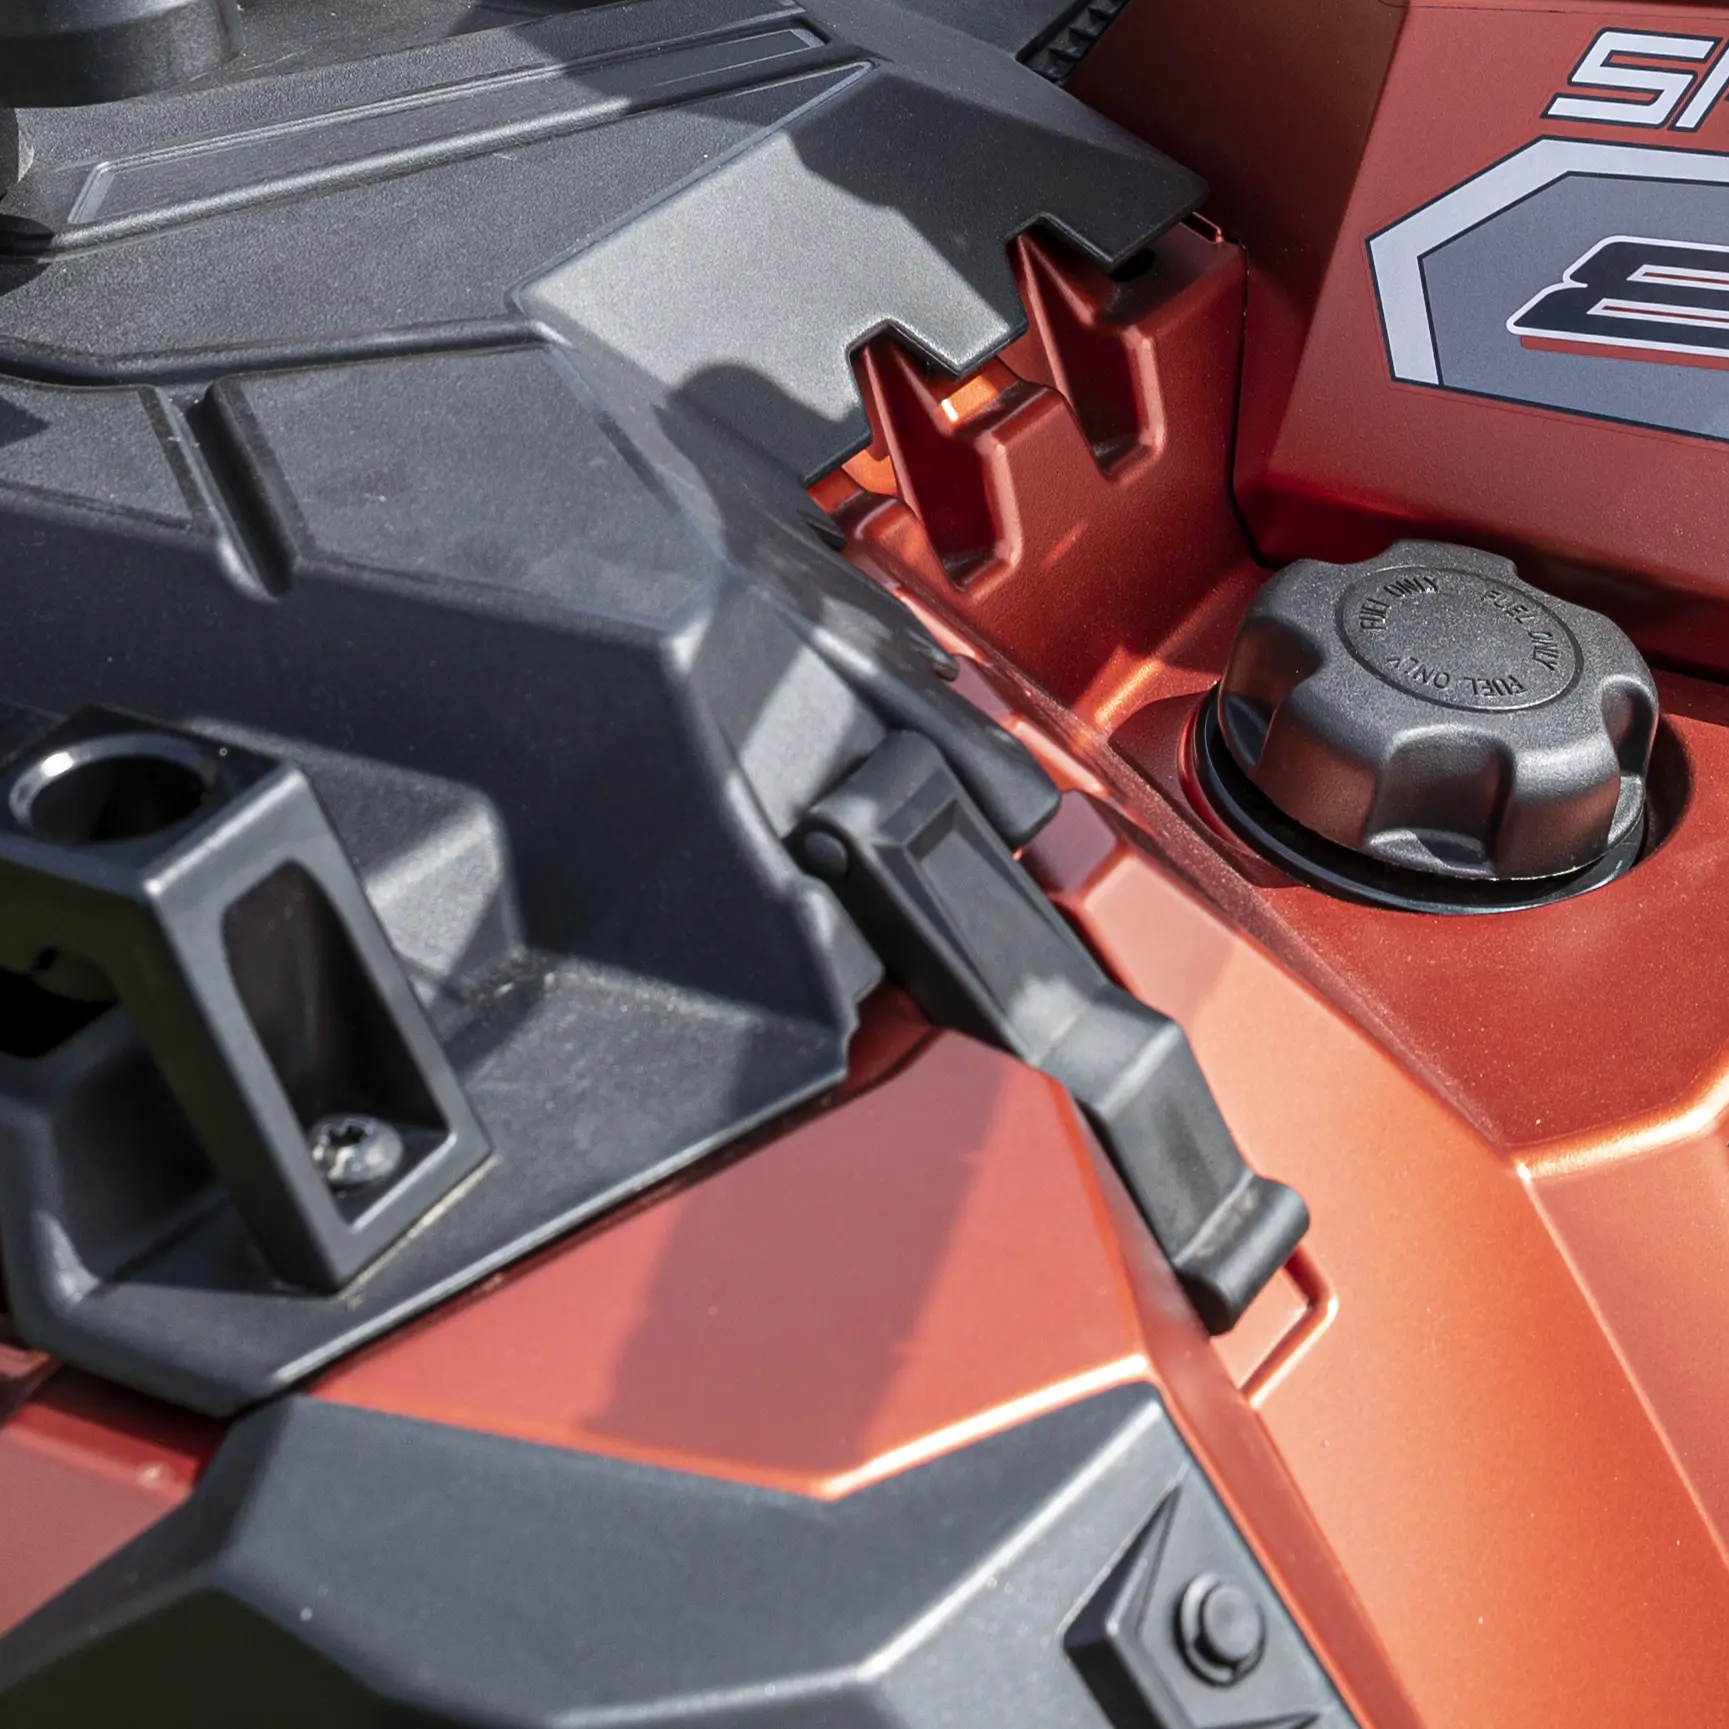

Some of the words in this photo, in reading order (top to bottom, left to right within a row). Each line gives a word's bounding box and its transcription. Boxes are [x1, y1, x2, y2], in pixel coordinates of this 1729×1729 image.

[1360, 598, 1390, 631] FUEL
[1383, 576, 1439, 598] ONLY
[1481, 589, 1536, 624] FUEL
[1528, 630, 1560, 672] ONLY
[1387, 656, 1451, 689] ONLY
[1463, 674, 1528, 697] FUEL
